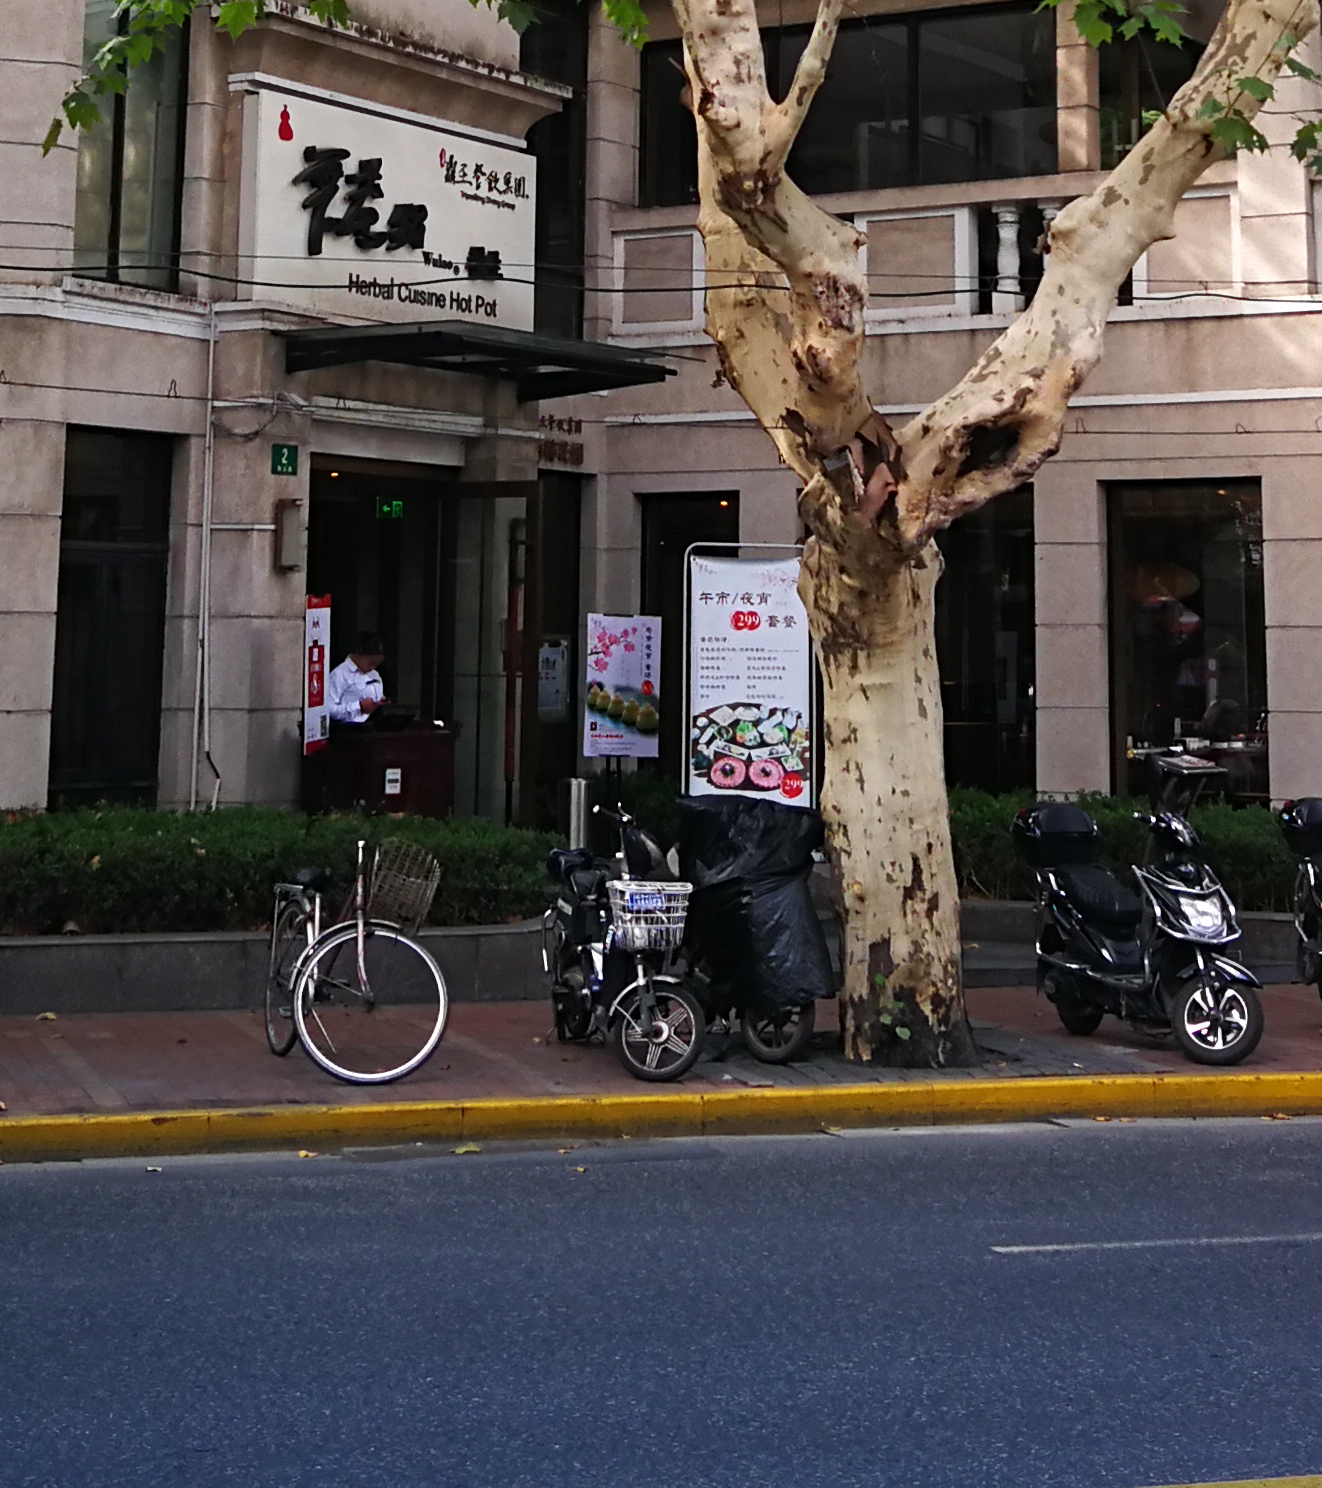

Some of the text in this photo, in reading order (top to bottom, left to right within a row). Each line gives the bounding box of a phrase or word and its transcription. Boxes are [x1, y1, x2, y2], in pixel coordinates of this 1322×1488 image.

[348, 273, 497, 318] Herbal Cuisine Hot Pot
[737, 614, 760, 627] 299
[785, 779, 804, 790] 299
